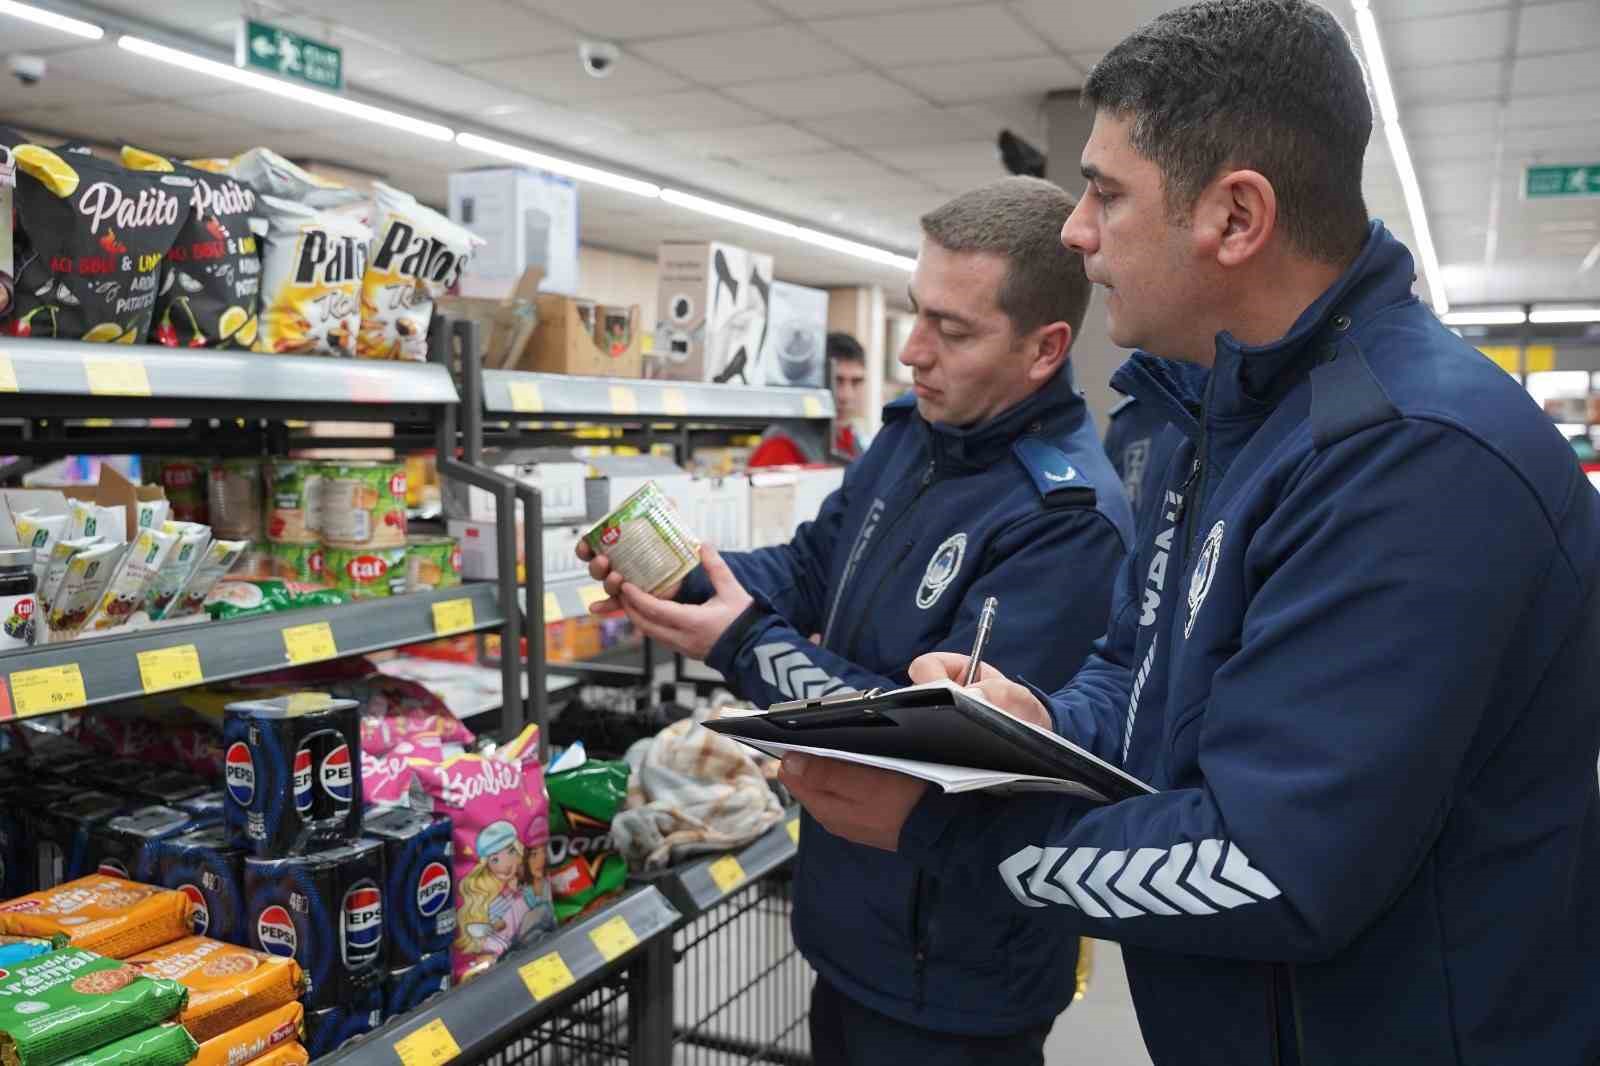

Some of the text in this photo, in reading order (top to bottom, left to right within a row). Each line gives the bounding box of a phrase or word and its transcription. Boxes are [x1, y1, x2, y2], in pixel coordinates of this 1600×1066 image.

[79, 181, 178, 234] Patito
[121, 256, 133, 271] &
[373, 221, 468, 289] Patos
[226, 765, 255, 784] PEPSI
[434, 762, 521, 808] Barbie
[418, 881, 449, 902] PEPSI
[260, 925, 295, 945] PEPSI
